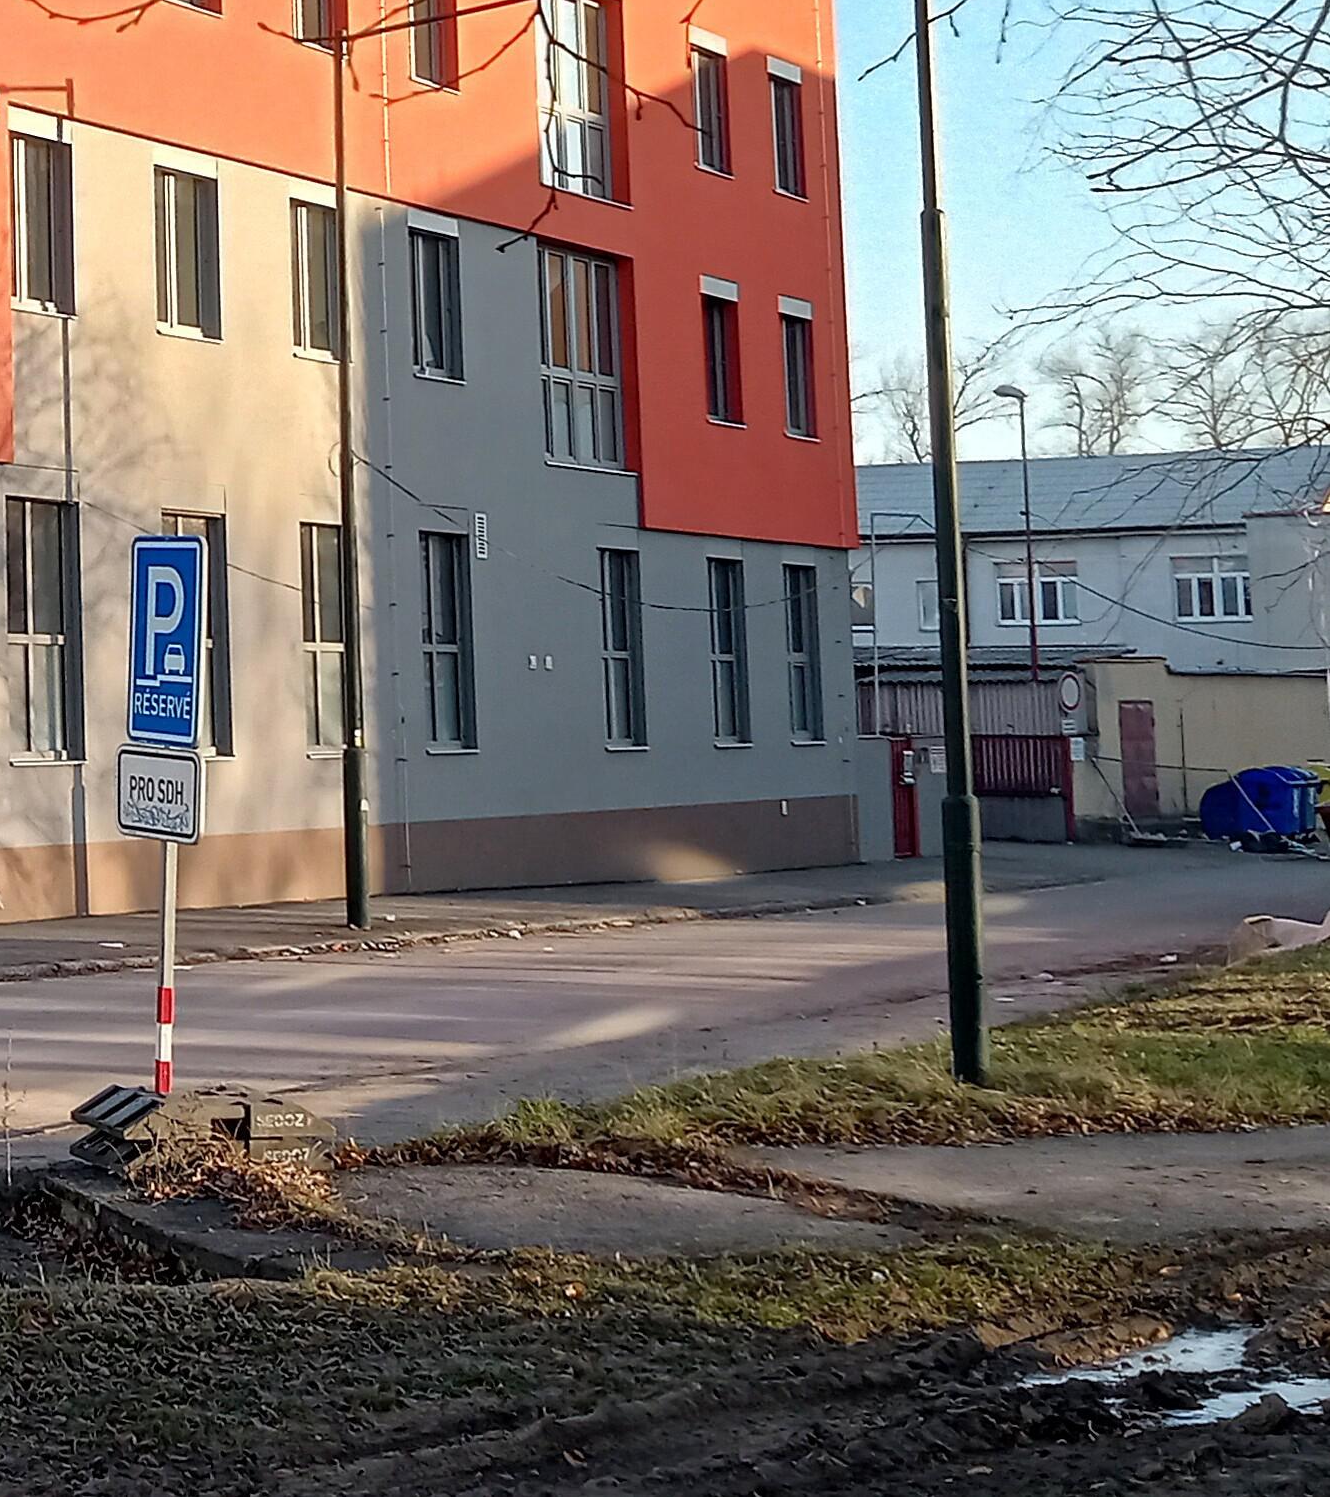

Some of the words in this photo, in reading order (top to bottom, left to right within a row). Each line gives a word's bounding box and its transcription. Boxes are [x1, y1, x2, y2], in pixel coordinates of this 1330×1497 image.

[145, 565, 185, 676] P
[134, 687, 191, 720] RÉSERVÉ
[129, 774, 155, 802] PRO
[157, 778, 184, 806] SDH
